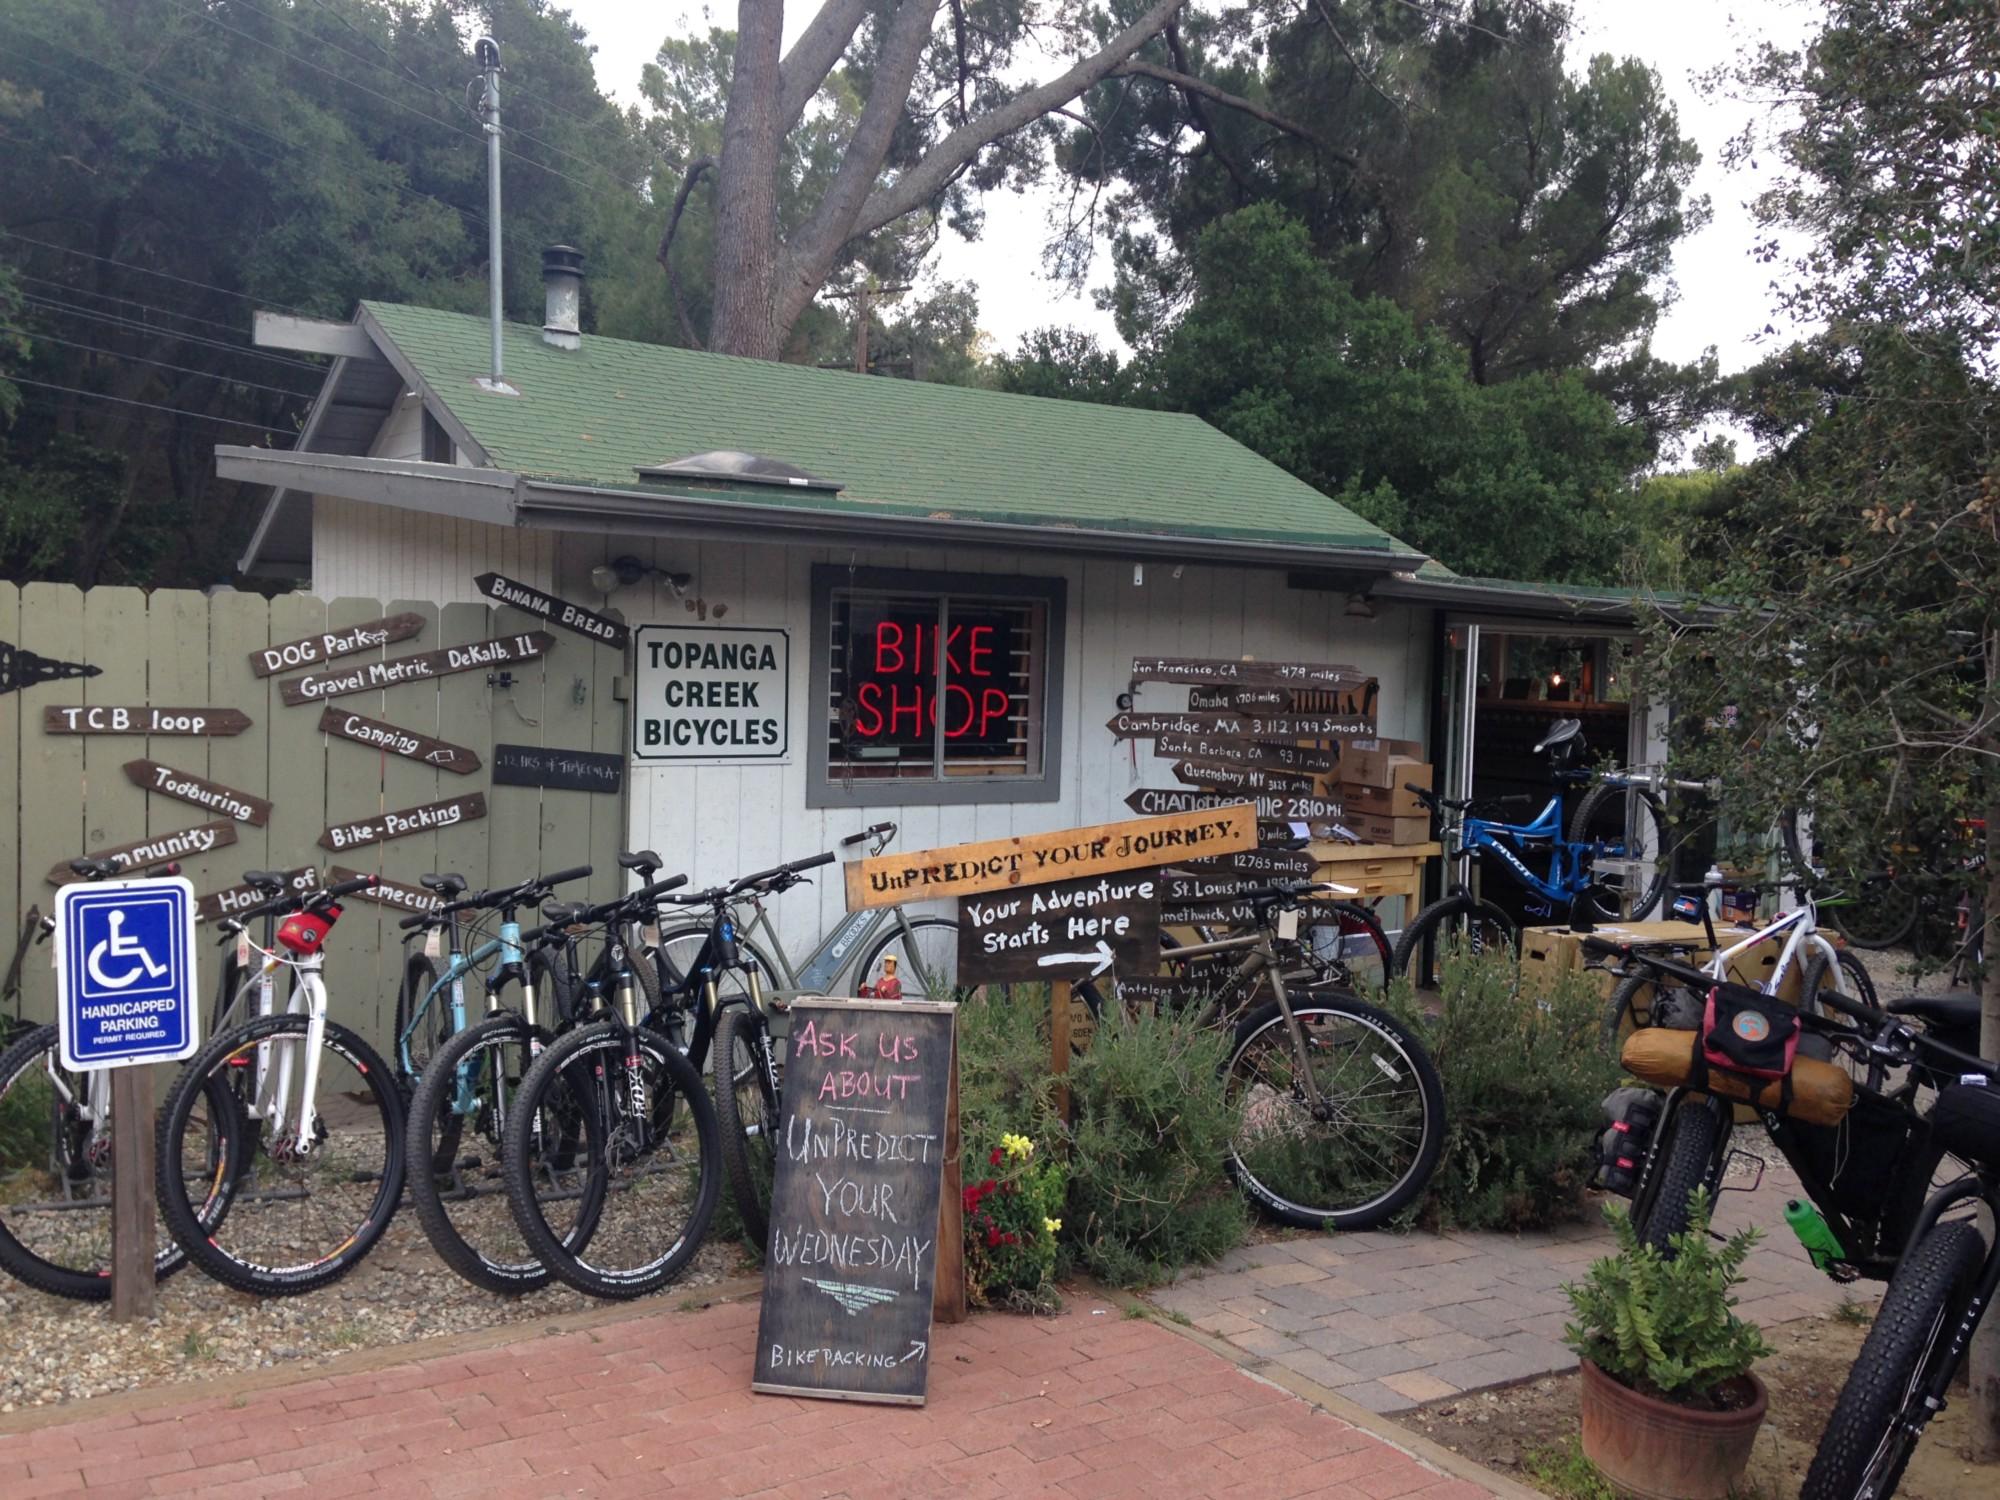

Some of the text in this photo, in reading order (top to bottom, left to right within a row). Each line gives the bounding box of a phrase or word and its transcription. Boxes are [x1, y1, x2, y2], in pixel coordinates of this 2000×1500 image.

[491, 578, 615, 639] BANANA BREAD
[263, 629, 368, 671] DOG Park
[647, 641, 777, 671] TOPANGA
[875, 621, 994, 677] BIKE
[300, 672, 364, 697] Gravel
[515, 636, 538, 656] IL
[1133, 661, 1152, 673] San
[1220, 665, 1237, 676] CA
[1281, 666, 1306, 679] 479
[1310, 669, 1341, 682] miles
[665, 680, 759, 708] CREEK
[1190, 692, 1229, 708] Omaha
[1258, 692, 1281, 702] miles
[152, 710, 205, 734] loop
[855, 682, 1009, 739] SHOP
[344, 716, 418, 752] Camping
[644, 719, 778, 746] BICYCLES
[1214, 720, 1241, 733] MA
[1322, 719, 1374, 734] Smoots
[1248, 749, 1262, 759] CA
[1306, 758, 1331, 768] miles
[1250, 772, 1265, 788] NY
[1288, 798, 1325, 818] 2810
[112, 828, 215, 867] mmunity
[1267, 828, 1288, 840] miles
[1034, 841, 1106, 868] YOUR
[1274, 859, 1309, 873] miles
[1491, 840, 1534, 878] PIVOT
[293, 868, 315, 890] of
[1173, 881, 1191, 897] St.
[967, 880, 1154, 928] Your Adventure
[1232, 906, 1255, 921] UK
[840, 915, 867, 948] BROOKS
[983, 914, 1131, 954] Starts Here
[1191, 962, 1240, 978] Las Vega
[1118, 982, 1173, 996] Antelope
[82, 999, 176, 1019] HANDICAPPED
[93, 1030, 166, 1044] PERMIT REQUIRED
[100, 1015, 159, 1033] PARKING
[818, 1071, 922, 1101] ABOUT
[815, 1172, 898, 1224] YOUR
[774, 1224, 932, 1291] WEDNESDAY
[1951, 1297, 1980, 1355] SURLY
